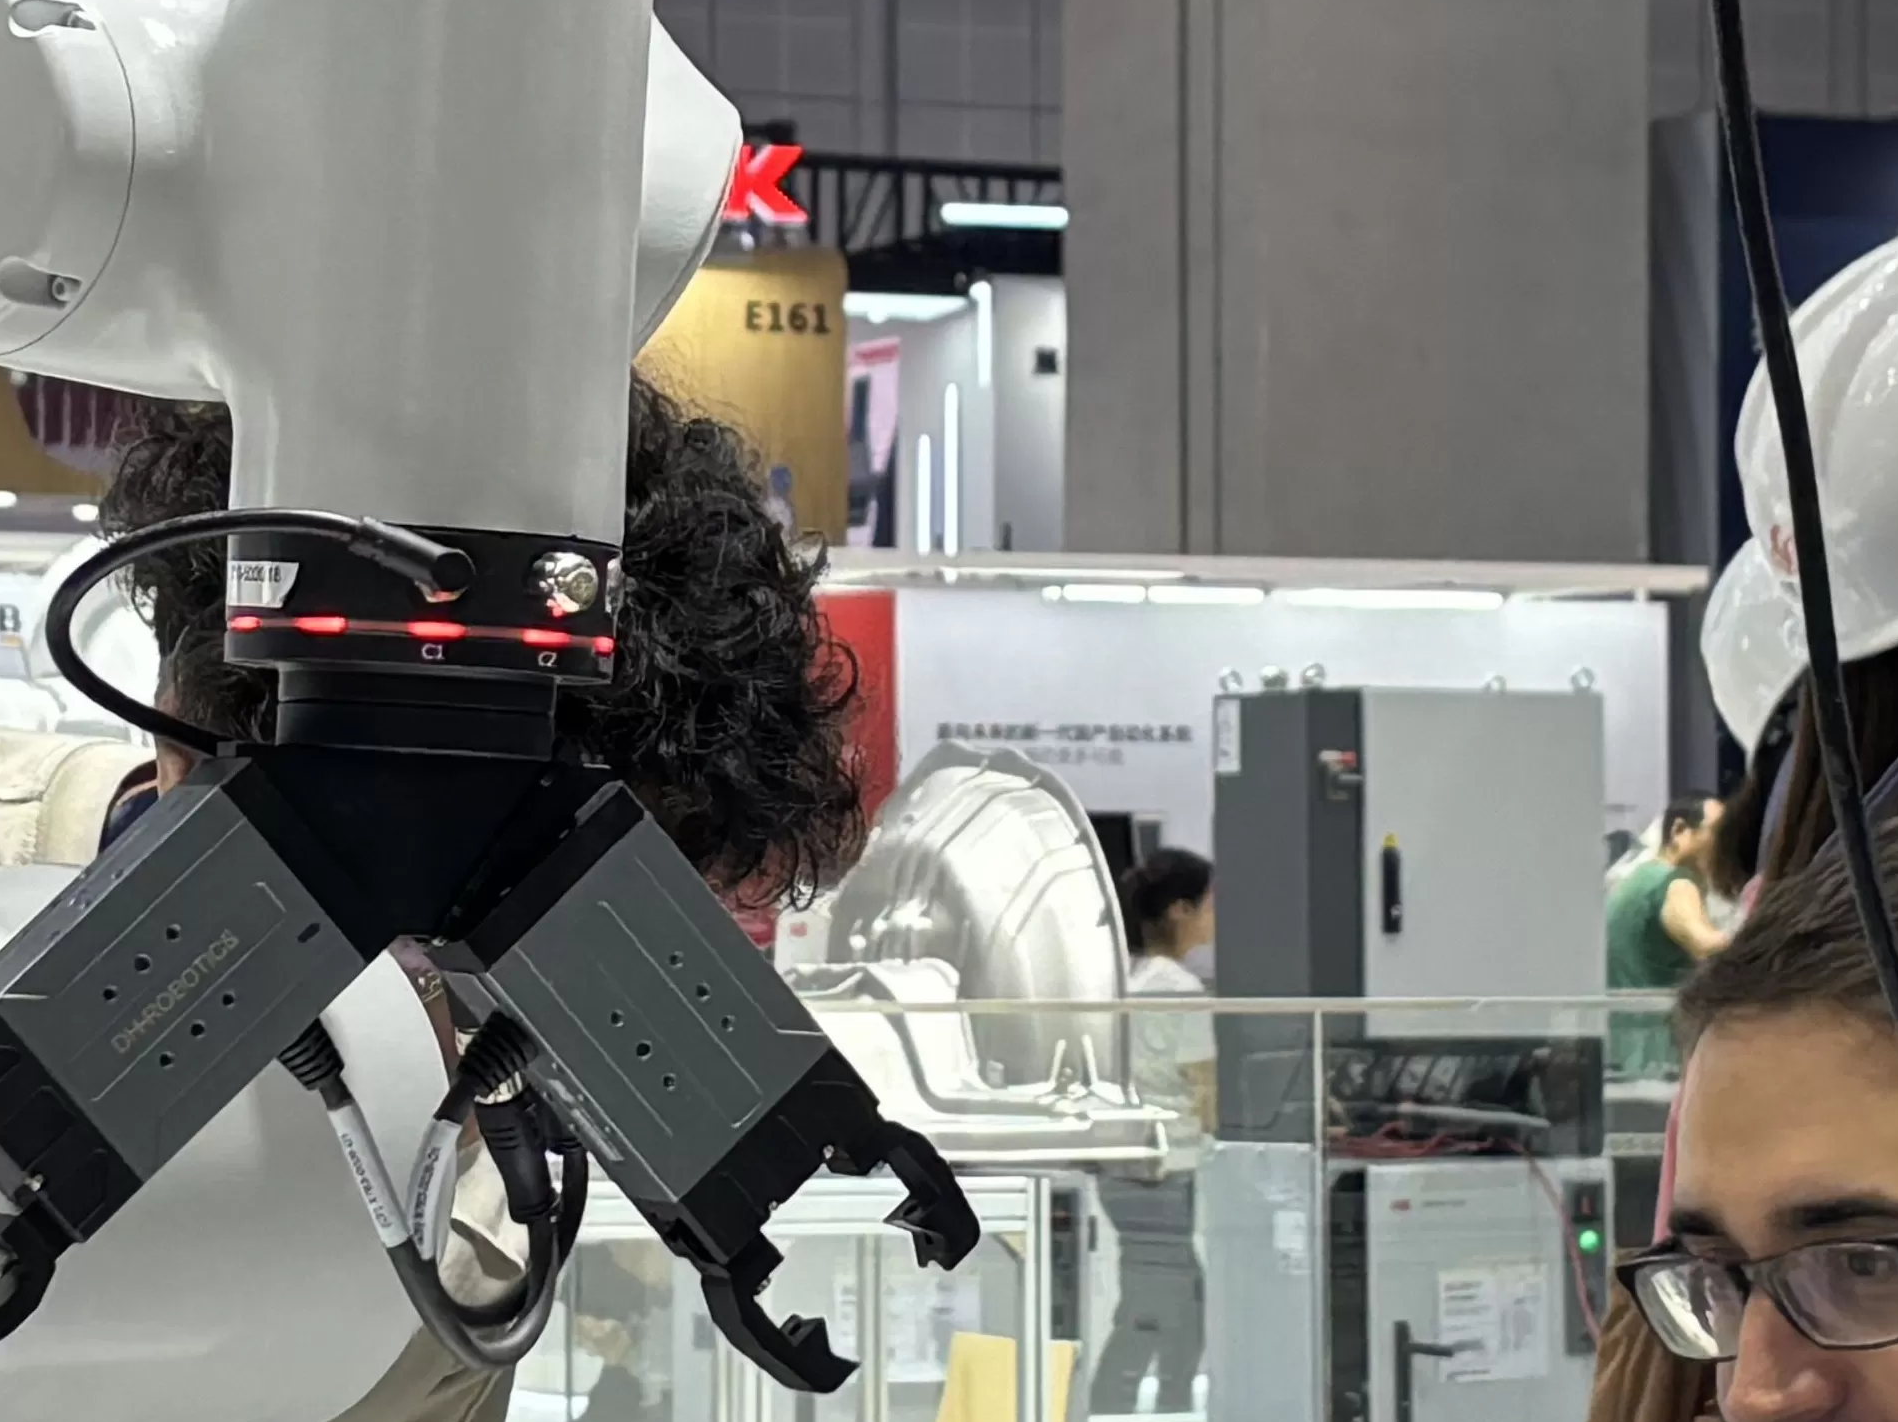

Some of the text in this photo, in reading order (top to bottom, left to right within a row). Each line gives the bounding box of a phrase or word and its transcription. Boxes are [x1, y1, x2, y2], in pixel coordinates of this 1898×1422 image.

[745, 300, 831, 336] E161
[420, 643, 445, 661] C1
[111, 928, 240, 1054] DH-ROBOTICS
